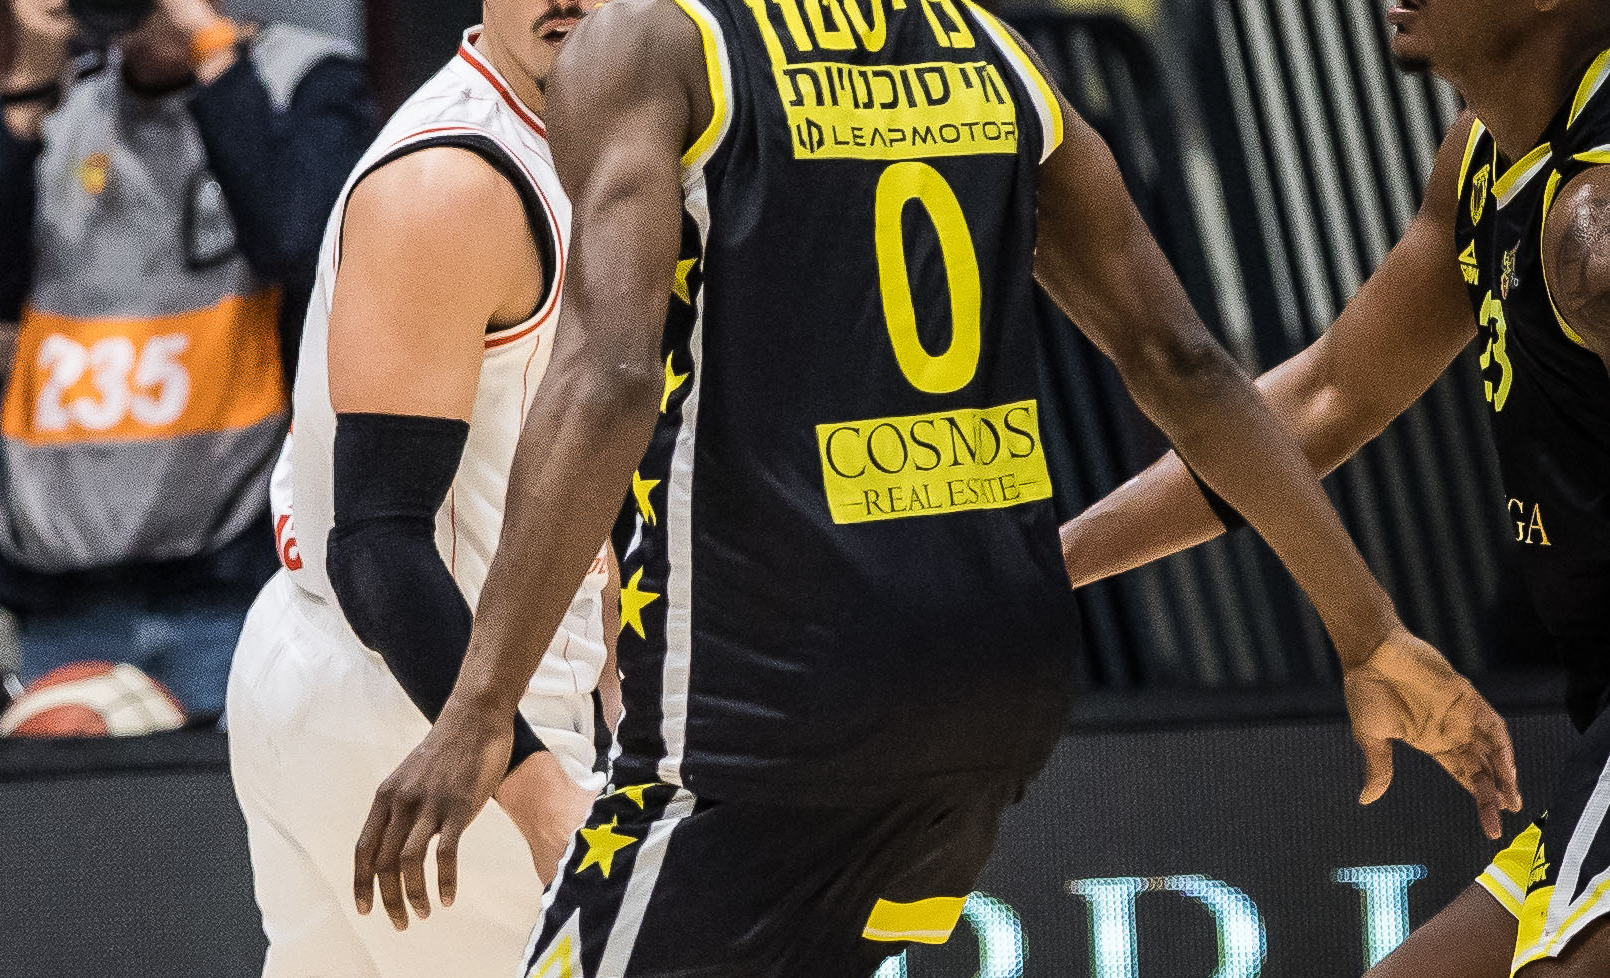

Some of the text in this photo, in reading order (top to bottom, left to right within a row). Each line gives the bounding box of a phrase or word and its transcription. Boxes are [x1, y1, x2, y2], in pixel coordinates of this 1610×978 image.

[783, 65, 1006, 110] חי סוכנויות
[832, 121, 1018, 148] LEAPMOTOR
[874, 161, 982, 394] 0
[34, 333, 191, 432] 235
[862, 483, 943, 516] REAL
